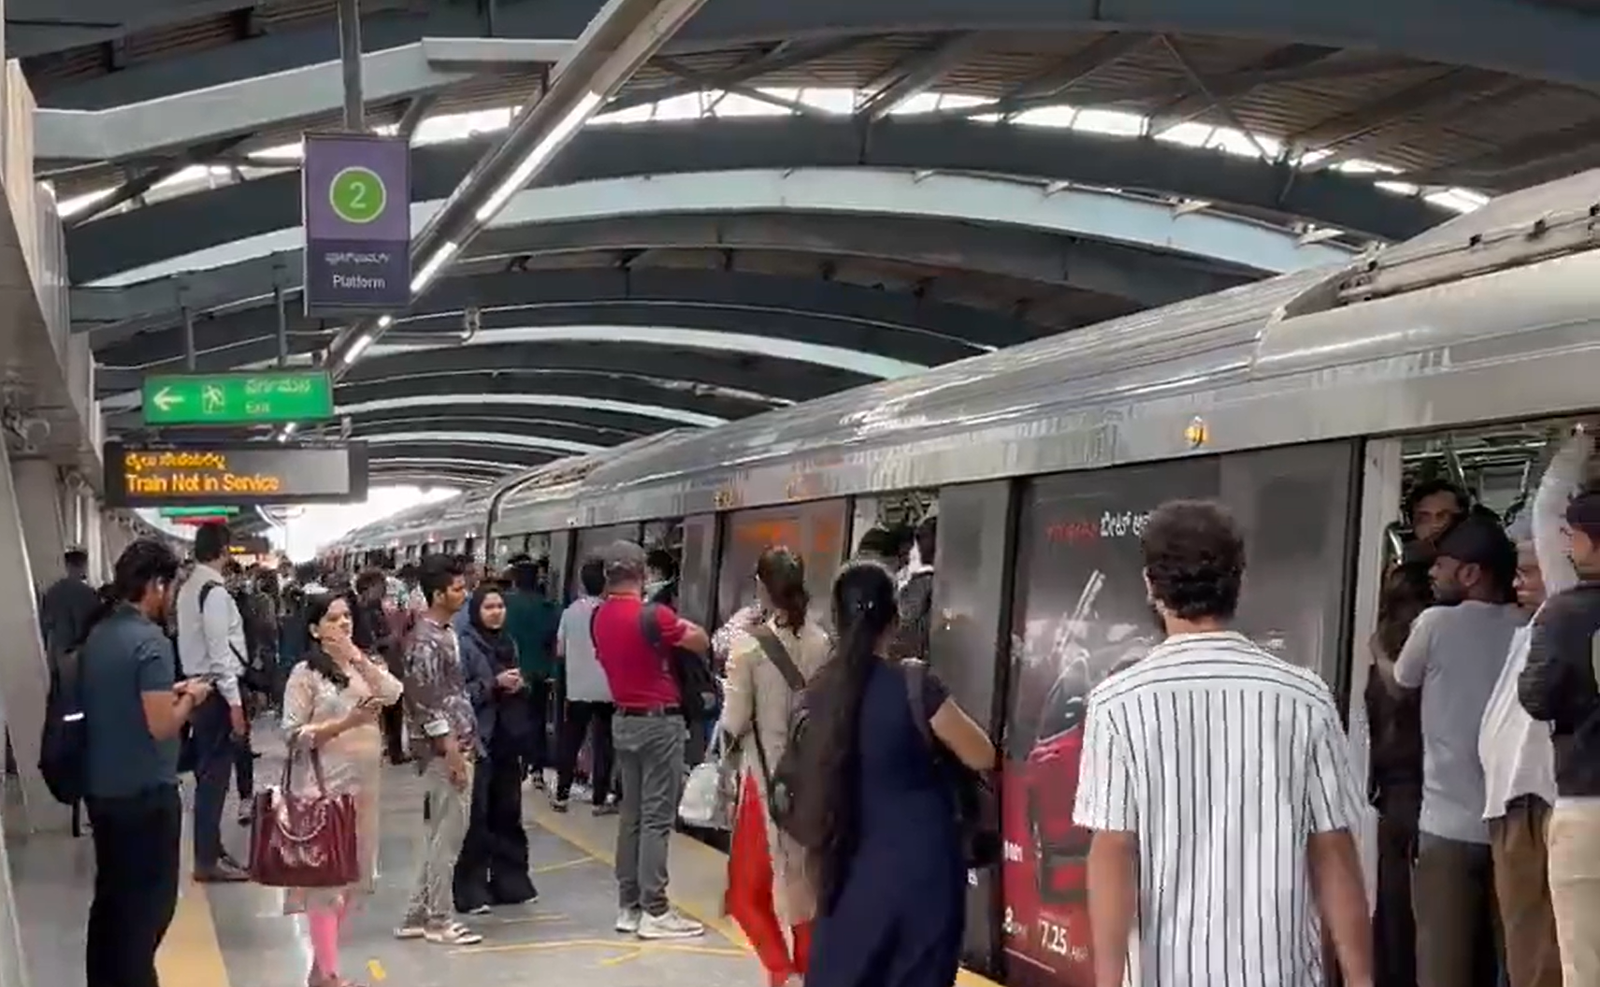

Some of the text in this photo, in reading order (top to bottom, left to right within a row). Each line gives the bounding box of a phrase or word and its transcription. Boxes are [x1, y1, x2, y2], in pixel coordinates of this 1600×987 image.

[349, 181, 368, 209] 2
[332, 274, 386, 289] Platform
[245, 401, 270, 414] Exit
[125, 473, 280, 493] Train Not in Service
[1040, 920, 1067, 956] 7.25
